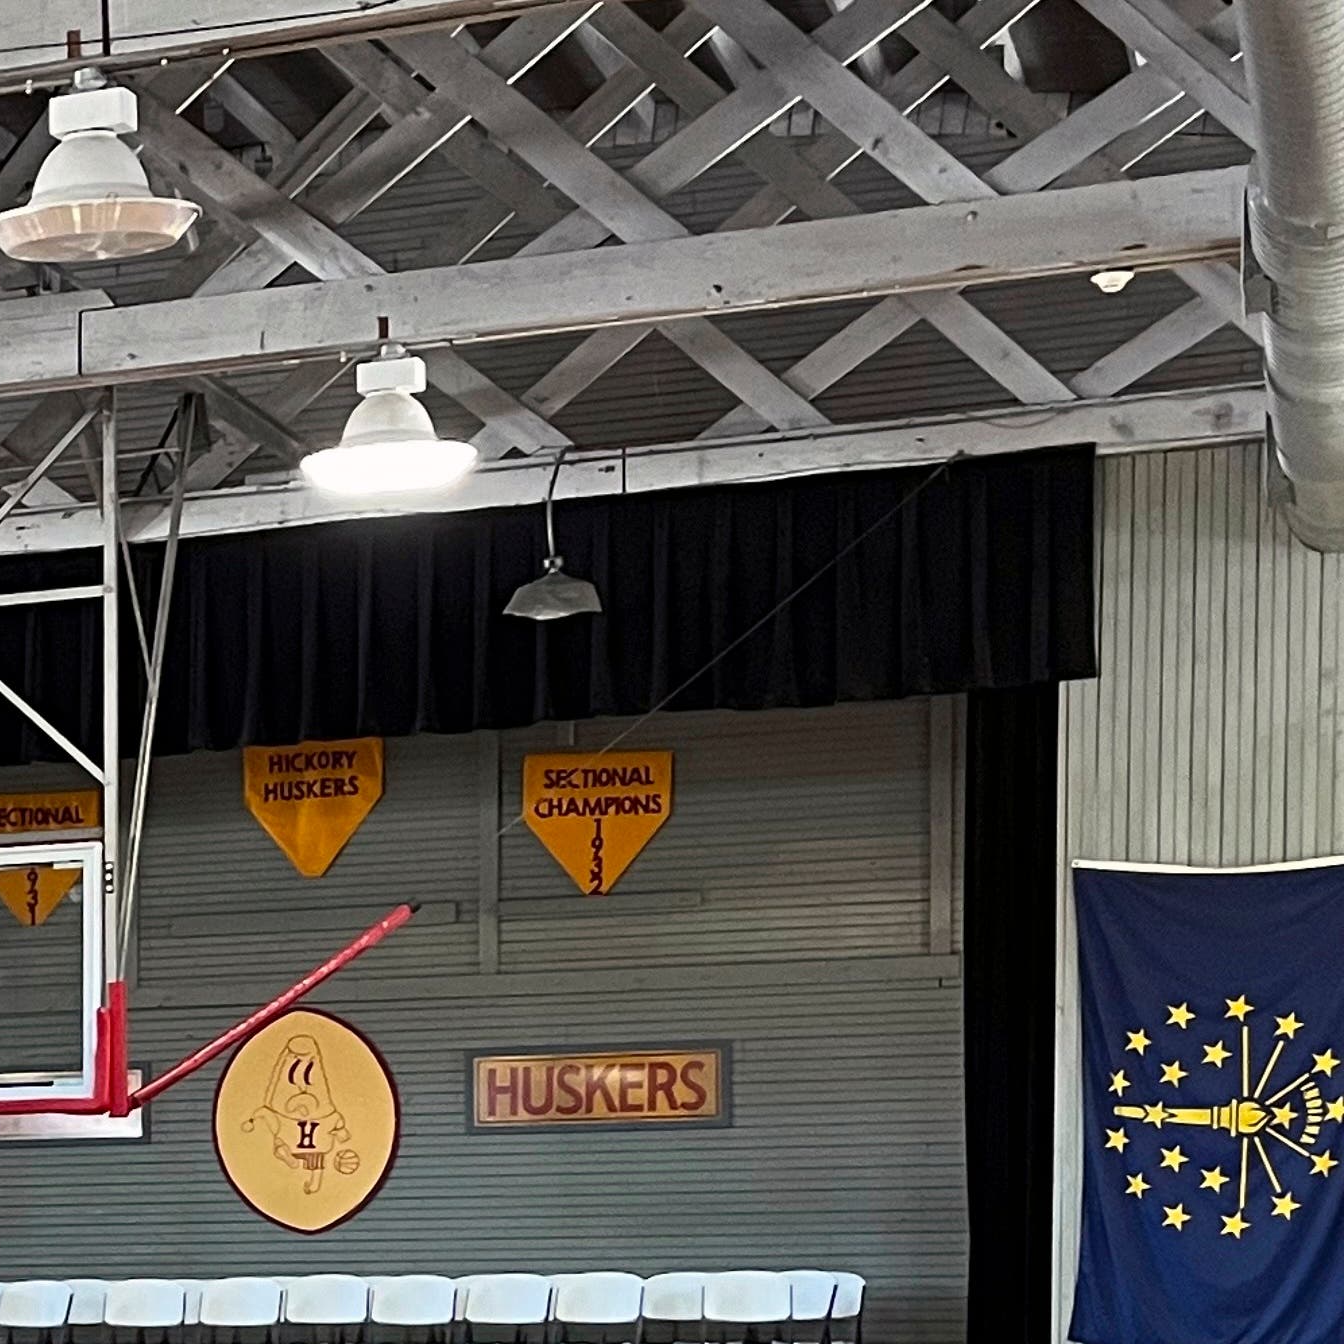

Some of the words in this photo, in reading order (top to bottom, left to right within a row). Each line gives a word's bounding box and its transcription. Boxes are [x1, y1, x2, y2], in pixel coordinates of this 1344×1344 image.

[268, 750, 357, 774] HICKORY
[263, 775, 360, 802] HUSKERS
[543, 765, 654, 790] SECTIONAL
[533, 793, 662, 819] CHAMPIONS
[487, 1060, 708, 1117] HUSKERS
[297, 1120, 320, 1149] H
